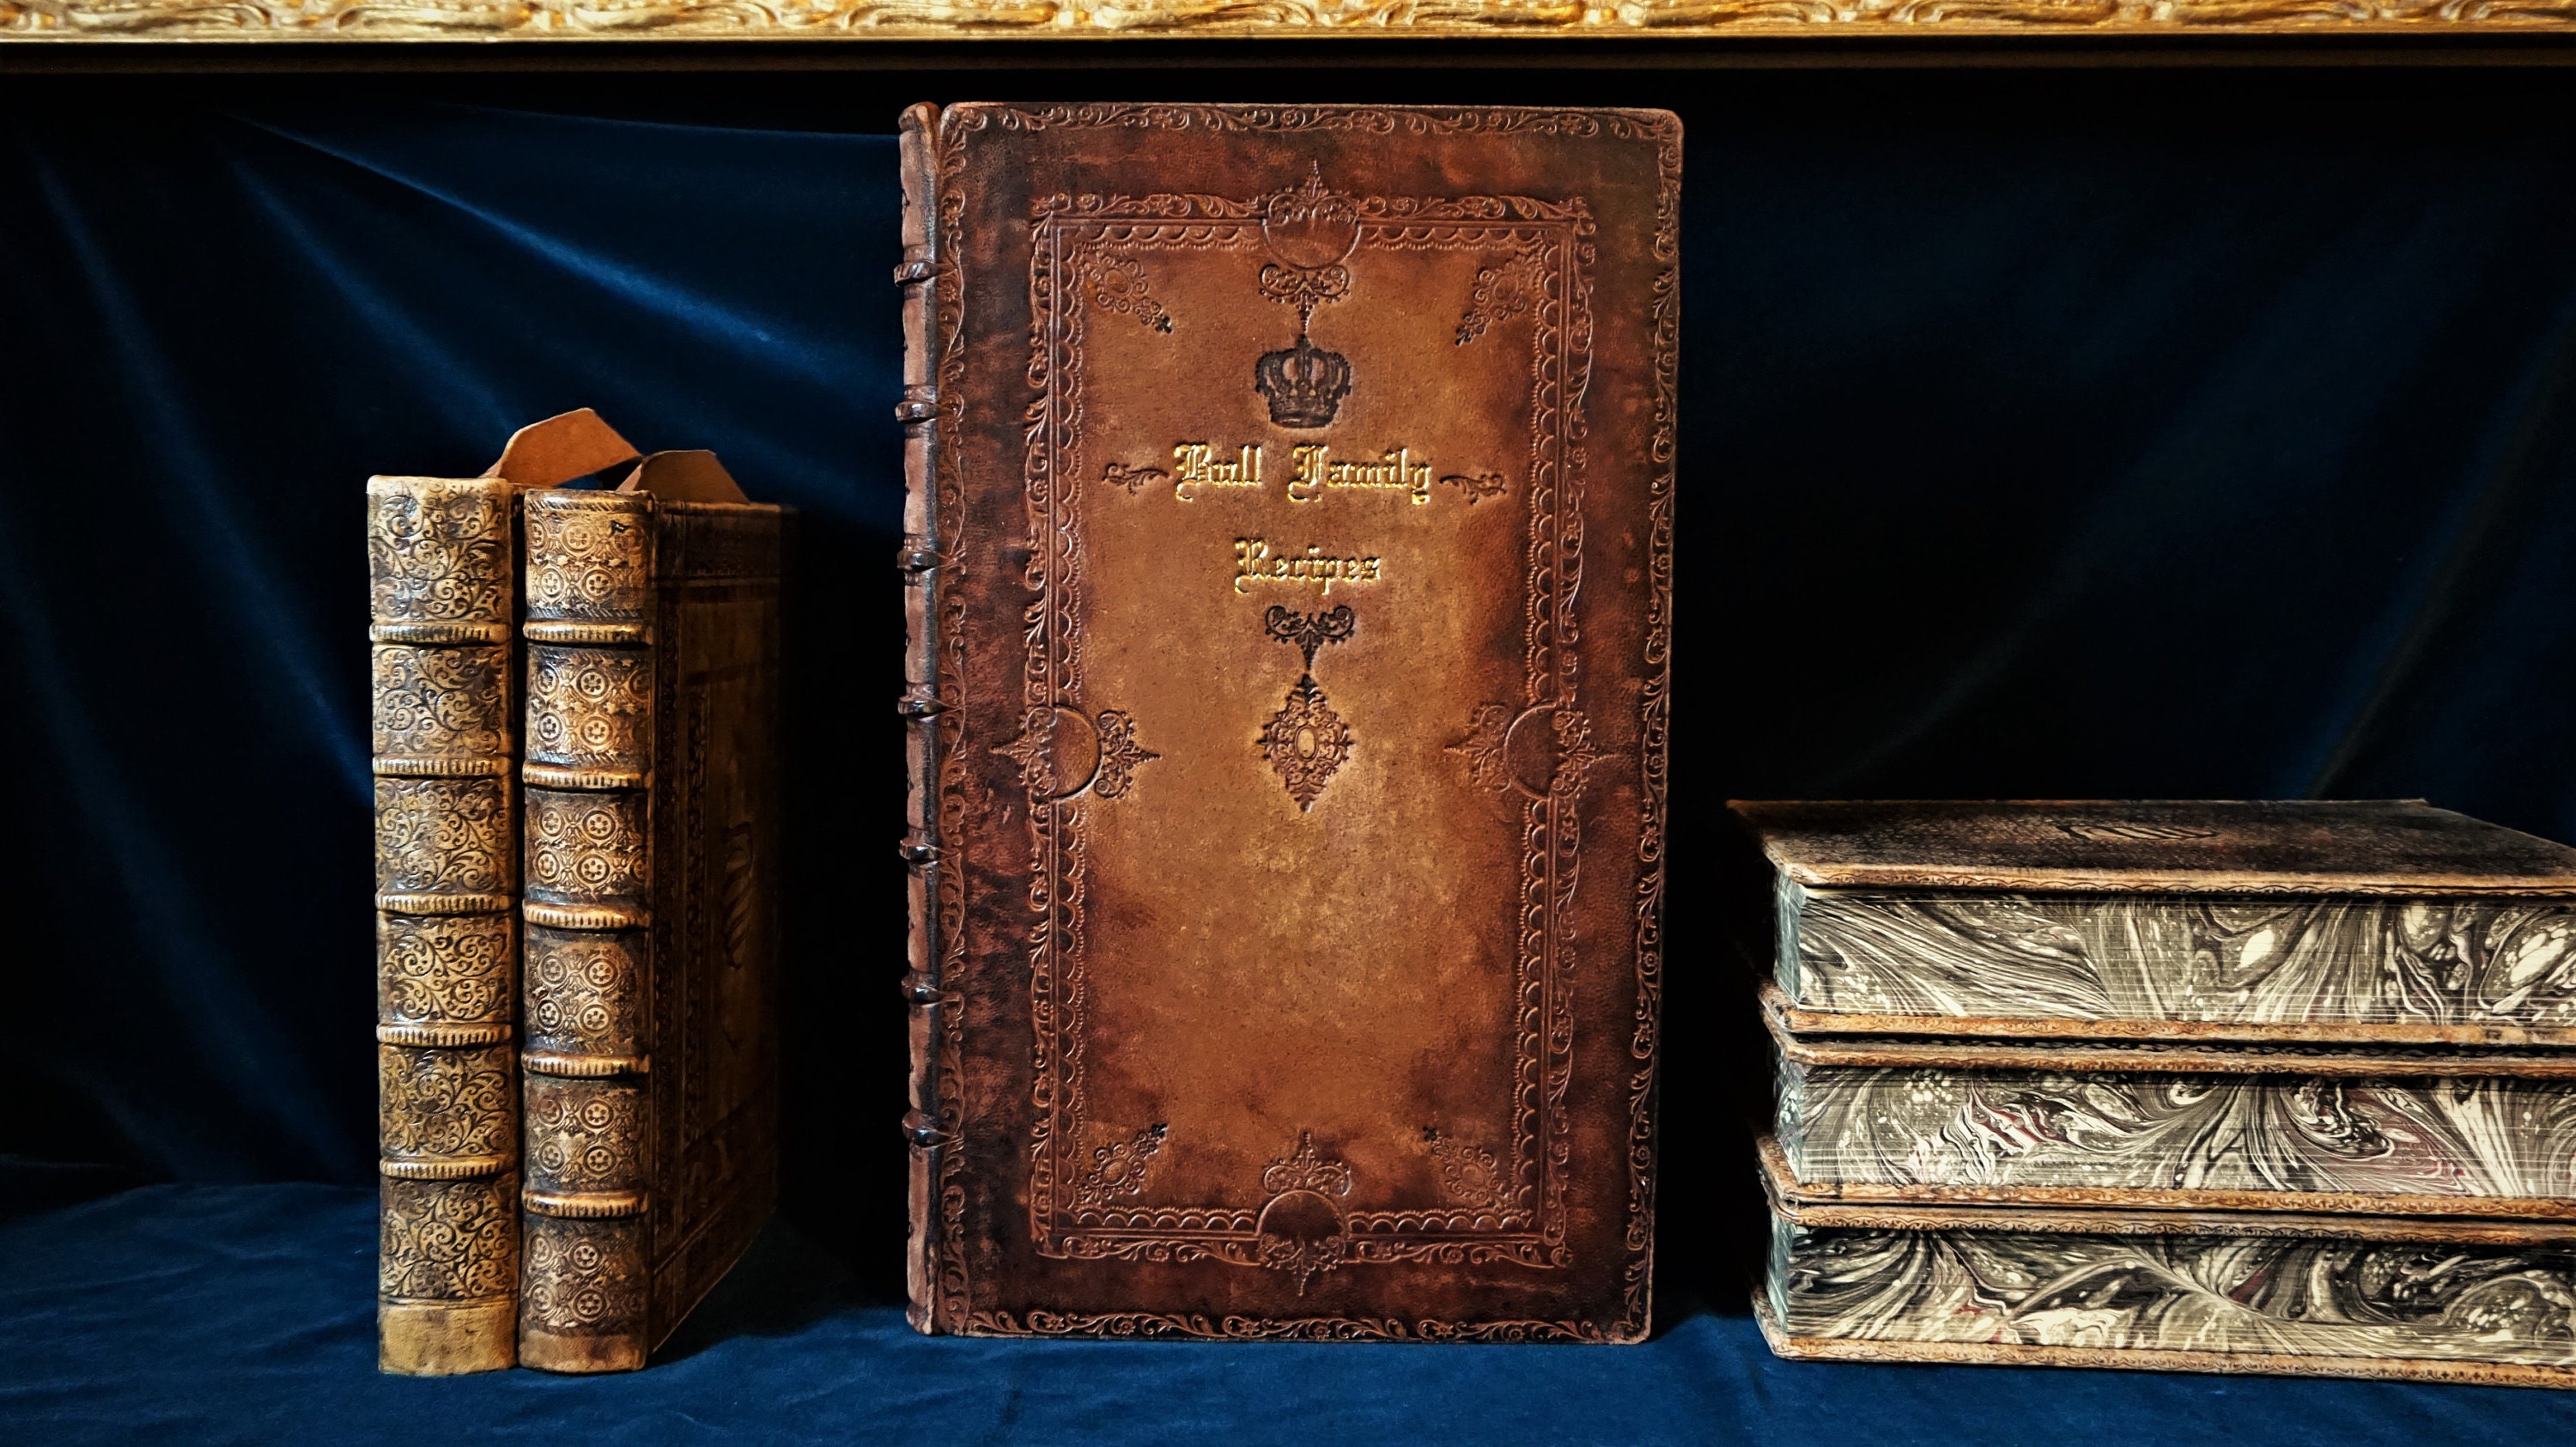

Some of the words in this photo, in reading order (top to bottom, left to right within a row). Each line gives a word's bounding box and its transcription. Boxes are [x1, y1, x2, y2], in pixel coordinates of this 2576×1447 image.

[1174, 443, 1262, 502] Bull
[1288, 443, 1431, 505] Family
[1234, 537, 1381, 595] Recipes
